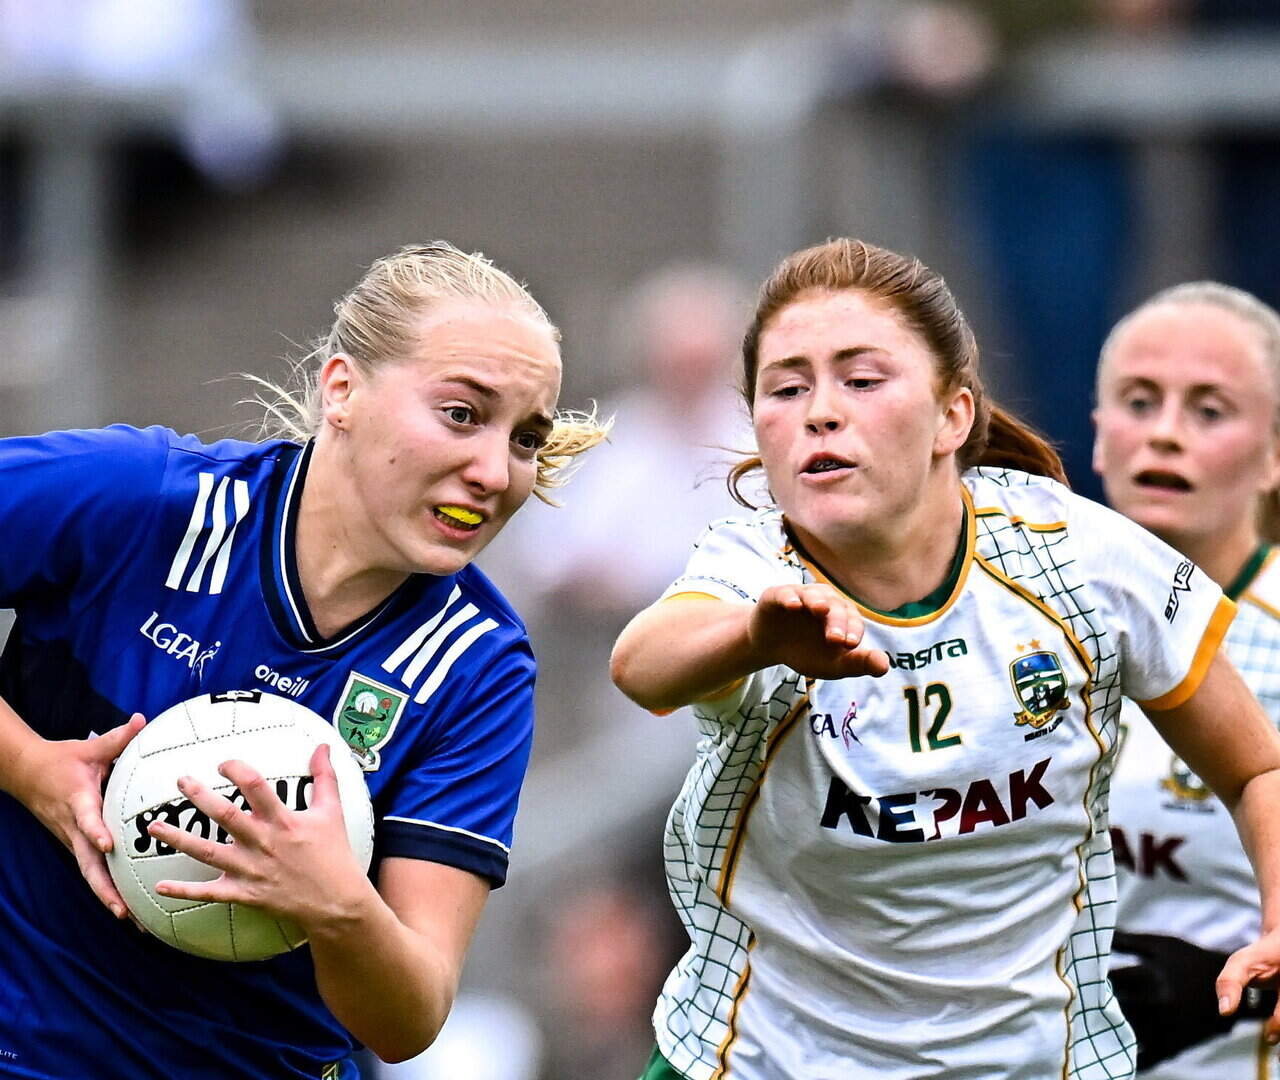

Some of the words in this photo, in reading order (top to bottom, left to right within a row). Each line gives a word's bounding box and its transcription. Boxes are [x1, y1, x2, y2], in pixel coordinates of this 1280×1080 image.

[140, 611, 200, 668] LGFA
[901, 682, 962, 753] 12
[820, 757, 1055, 843] KEPAK
